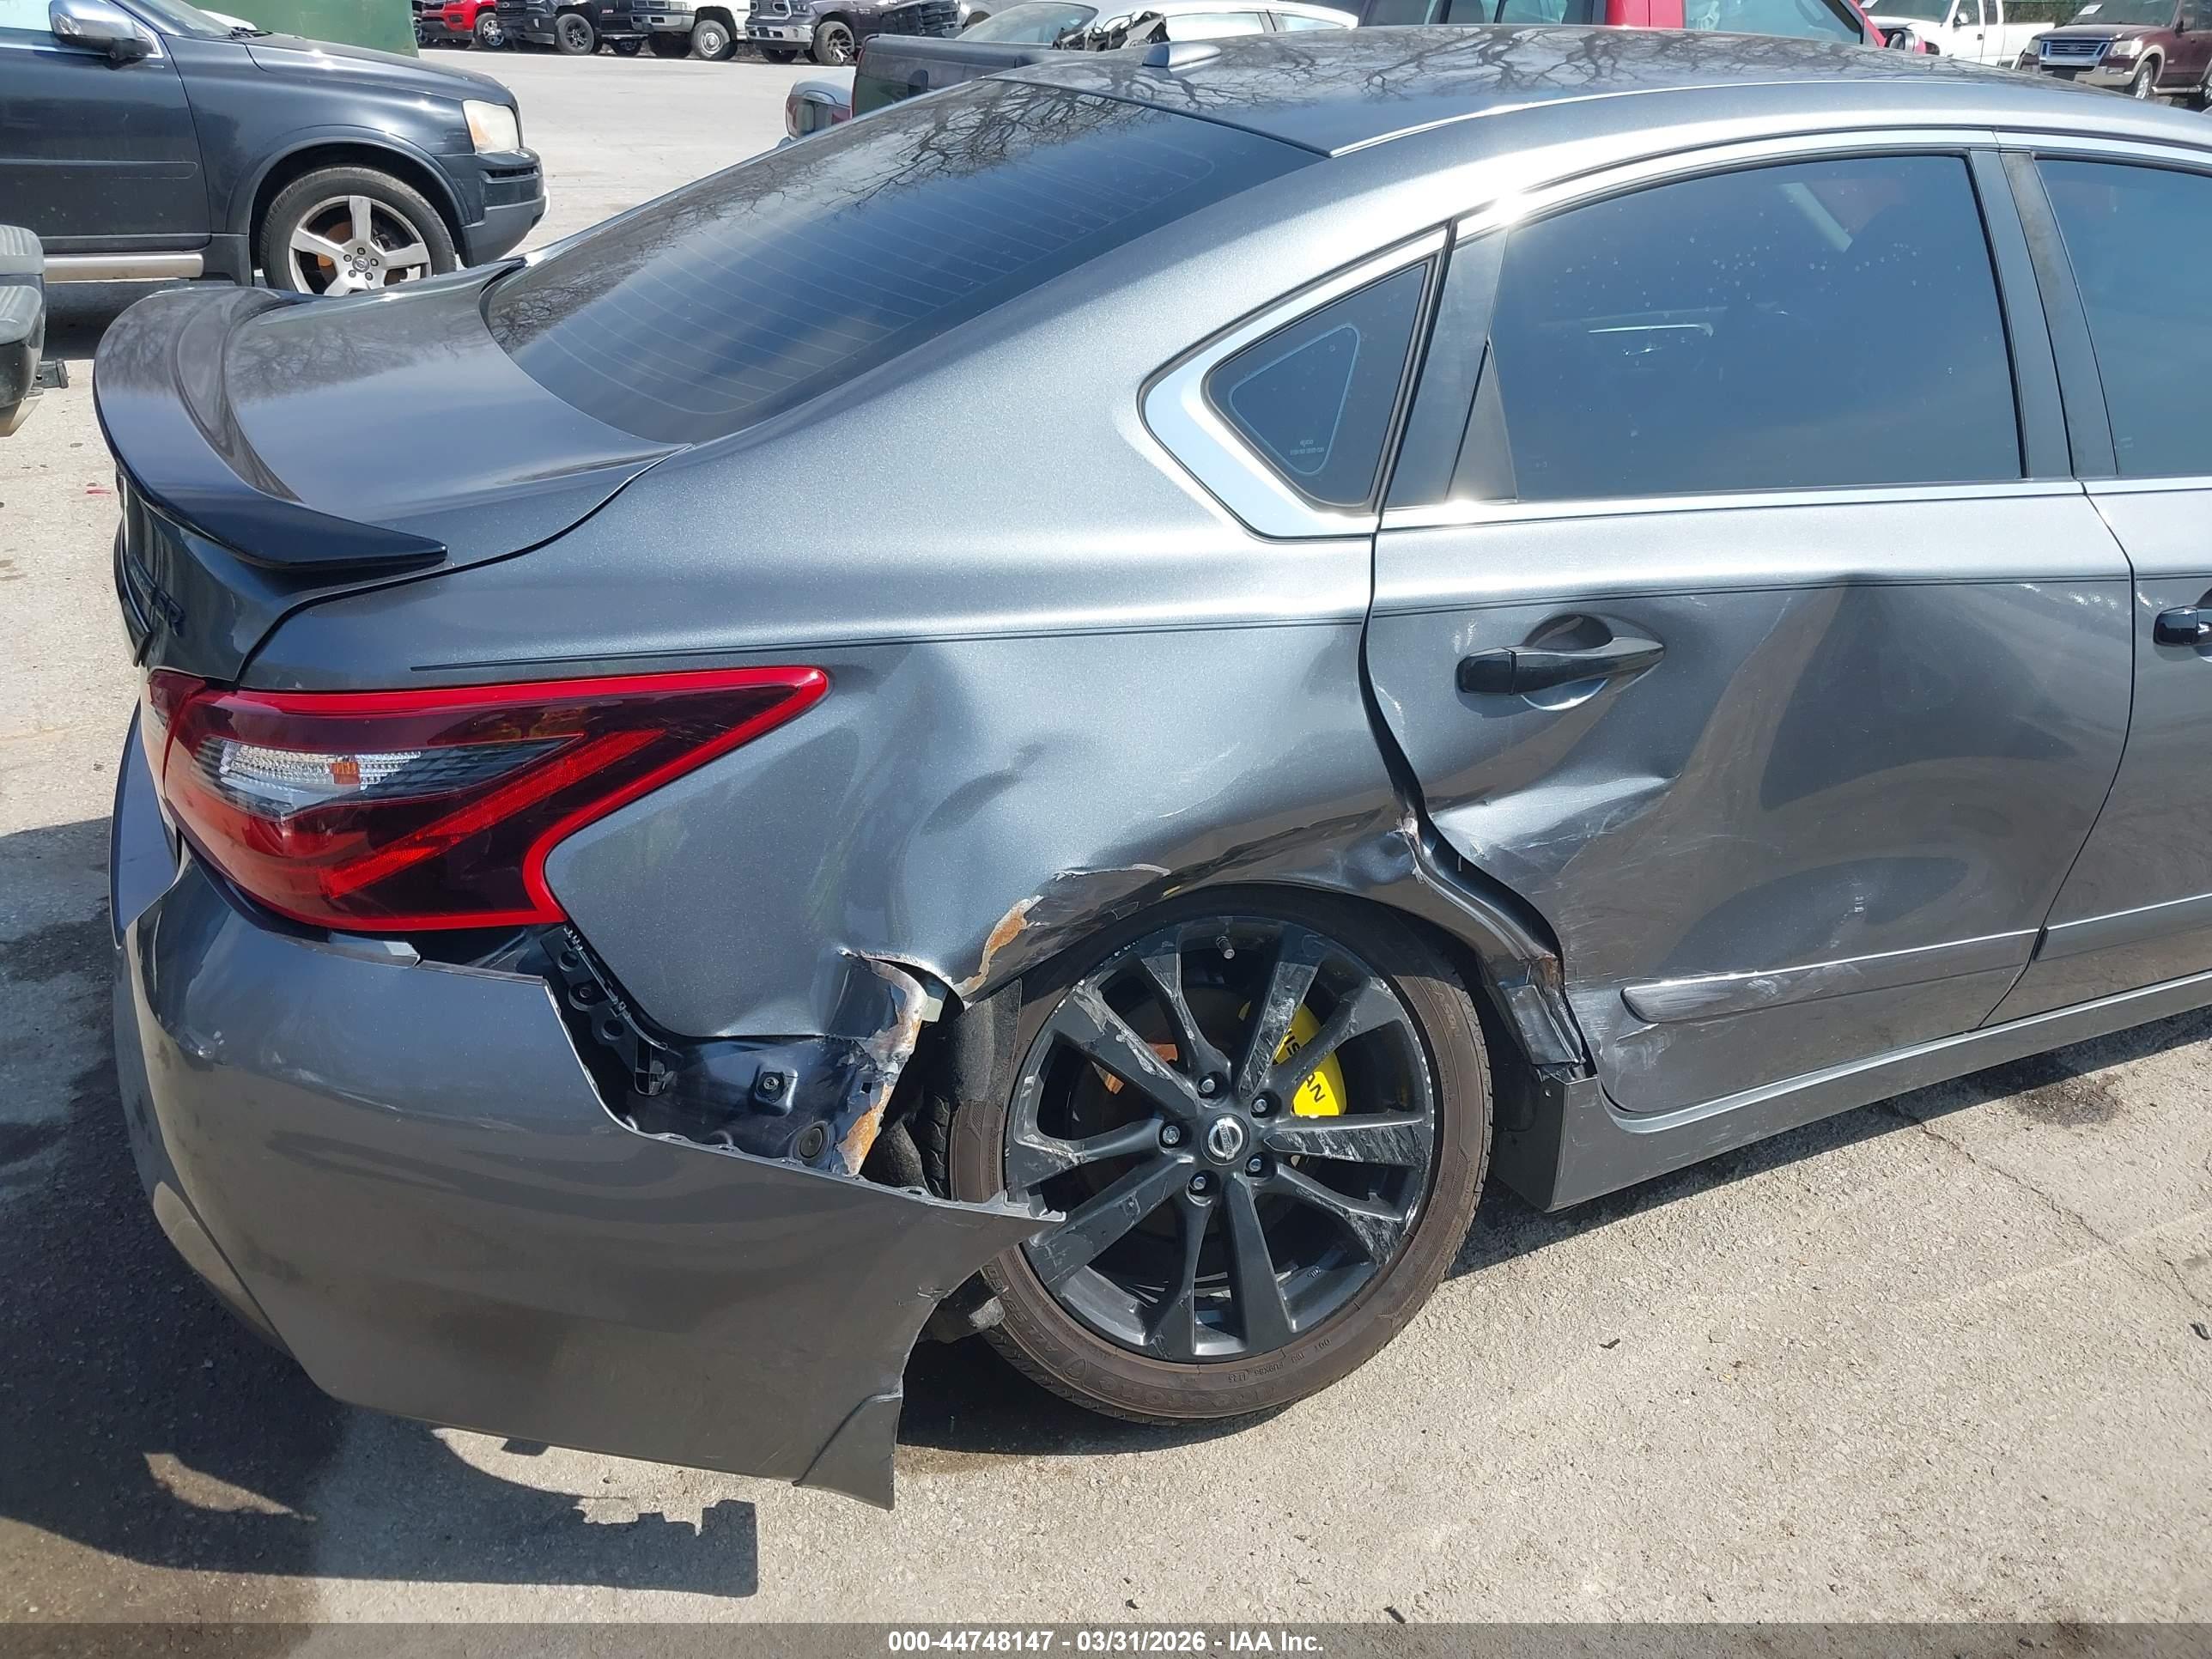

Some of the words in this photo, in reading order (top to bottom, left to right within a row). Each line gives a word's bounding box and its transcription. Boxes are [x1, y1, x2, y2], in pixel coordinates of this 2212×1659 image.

[1427, 981, 1463, 1038] EASON
[1285, 1030, 1327, 1103] ISAN
[981, 1264, 1029, 1323] SEASO
